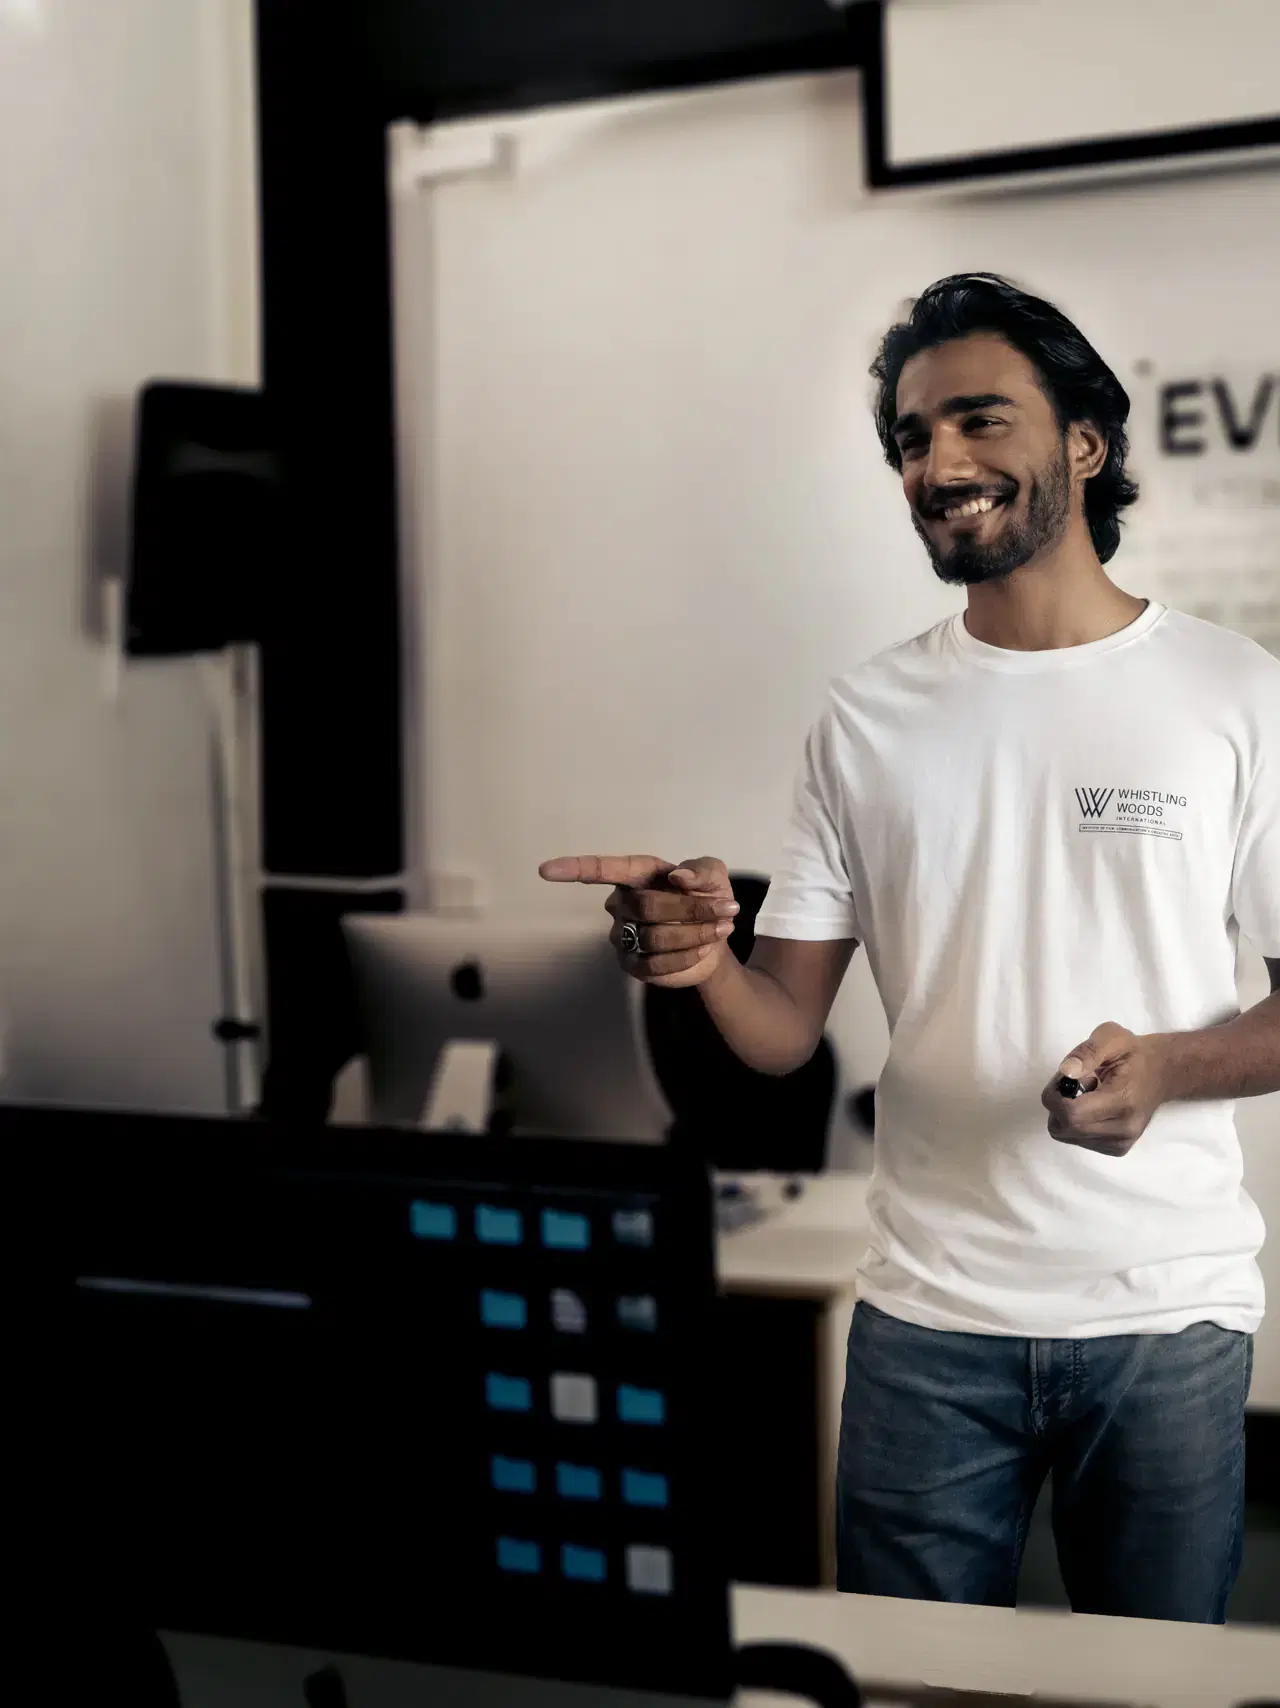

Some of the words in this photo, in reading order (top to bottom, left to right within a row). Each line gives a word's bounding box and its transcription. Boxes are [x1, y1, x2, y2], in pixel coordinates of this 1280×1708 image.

[1118, 788, 1187, 807] WHISTLING
[1117, 803, 1163, 817] WOODS
[1116, 816, 1166, 826] INTERNATIONAL
